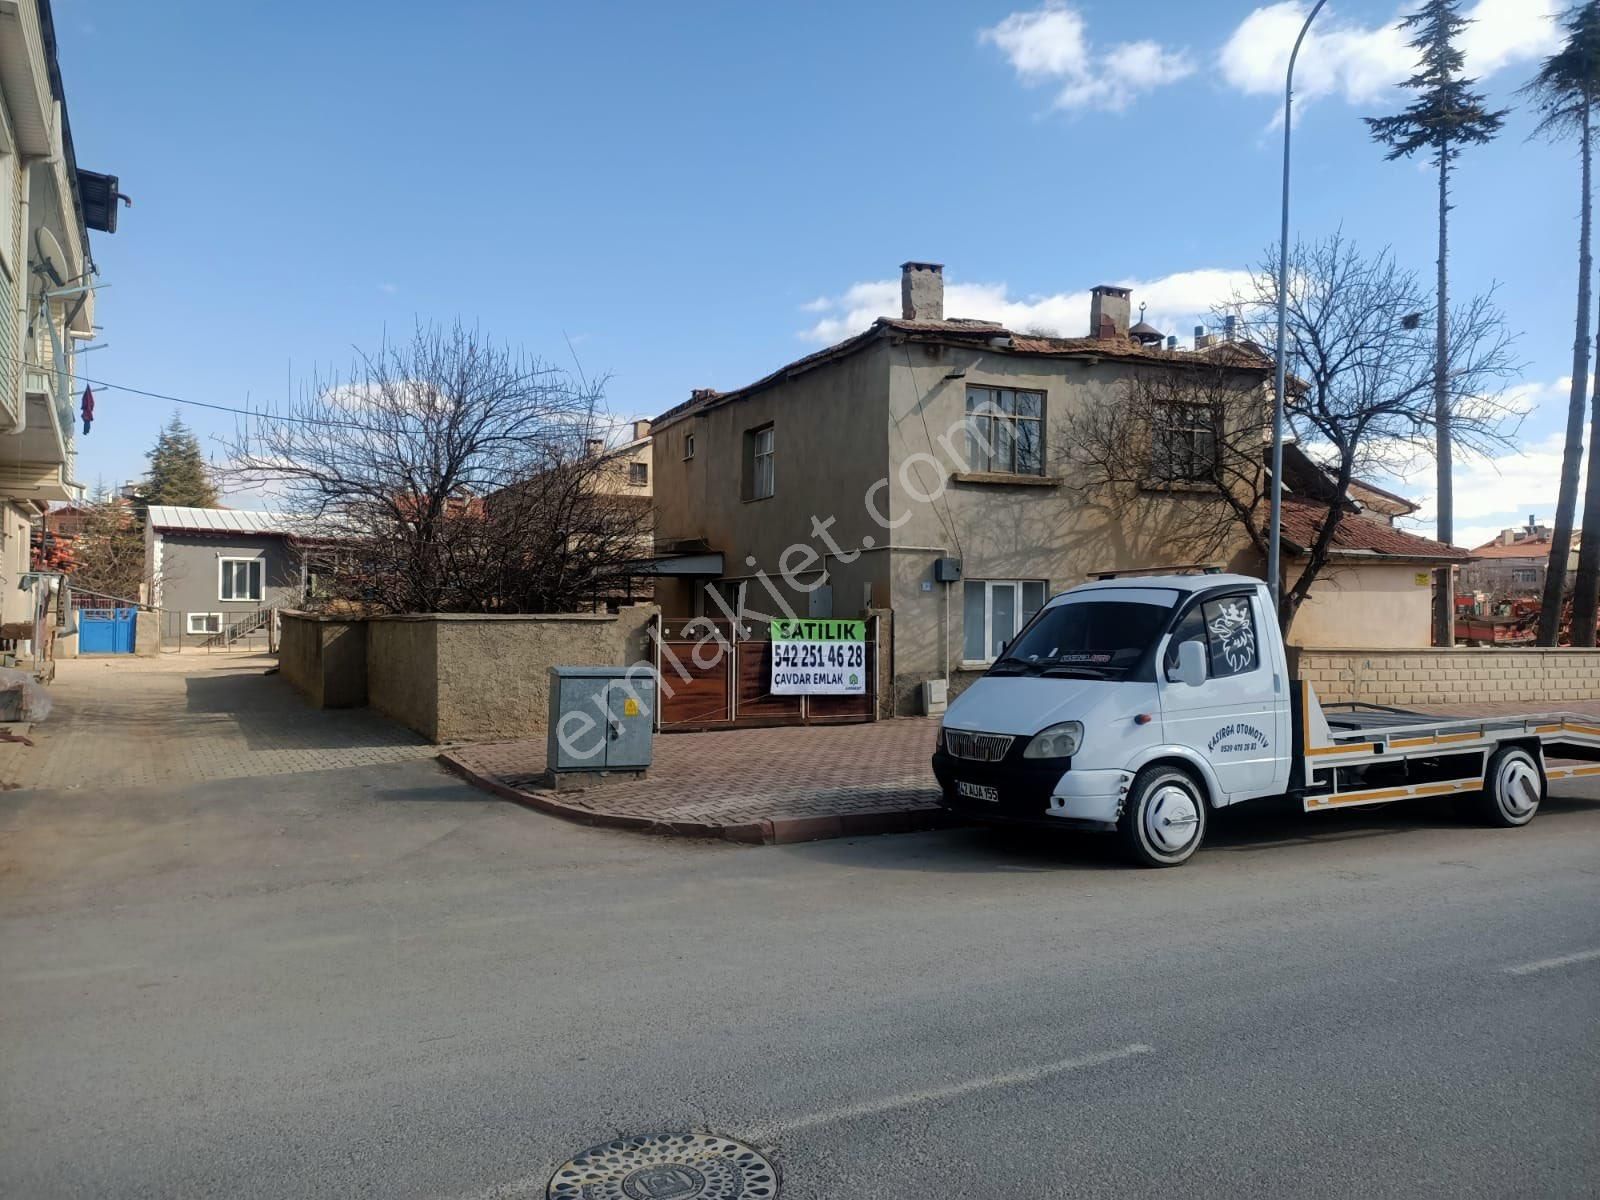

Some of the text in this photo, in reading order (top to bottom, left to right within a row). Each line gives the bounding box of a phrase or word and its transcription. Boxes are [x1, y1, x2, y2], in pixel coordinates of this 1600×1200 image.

[780, 622, 856, 640] SATILIK
[774, 645, 863, 668] 542 251 46 28
[774, 673, 844, 688] ÇAVDAR EMLAK
